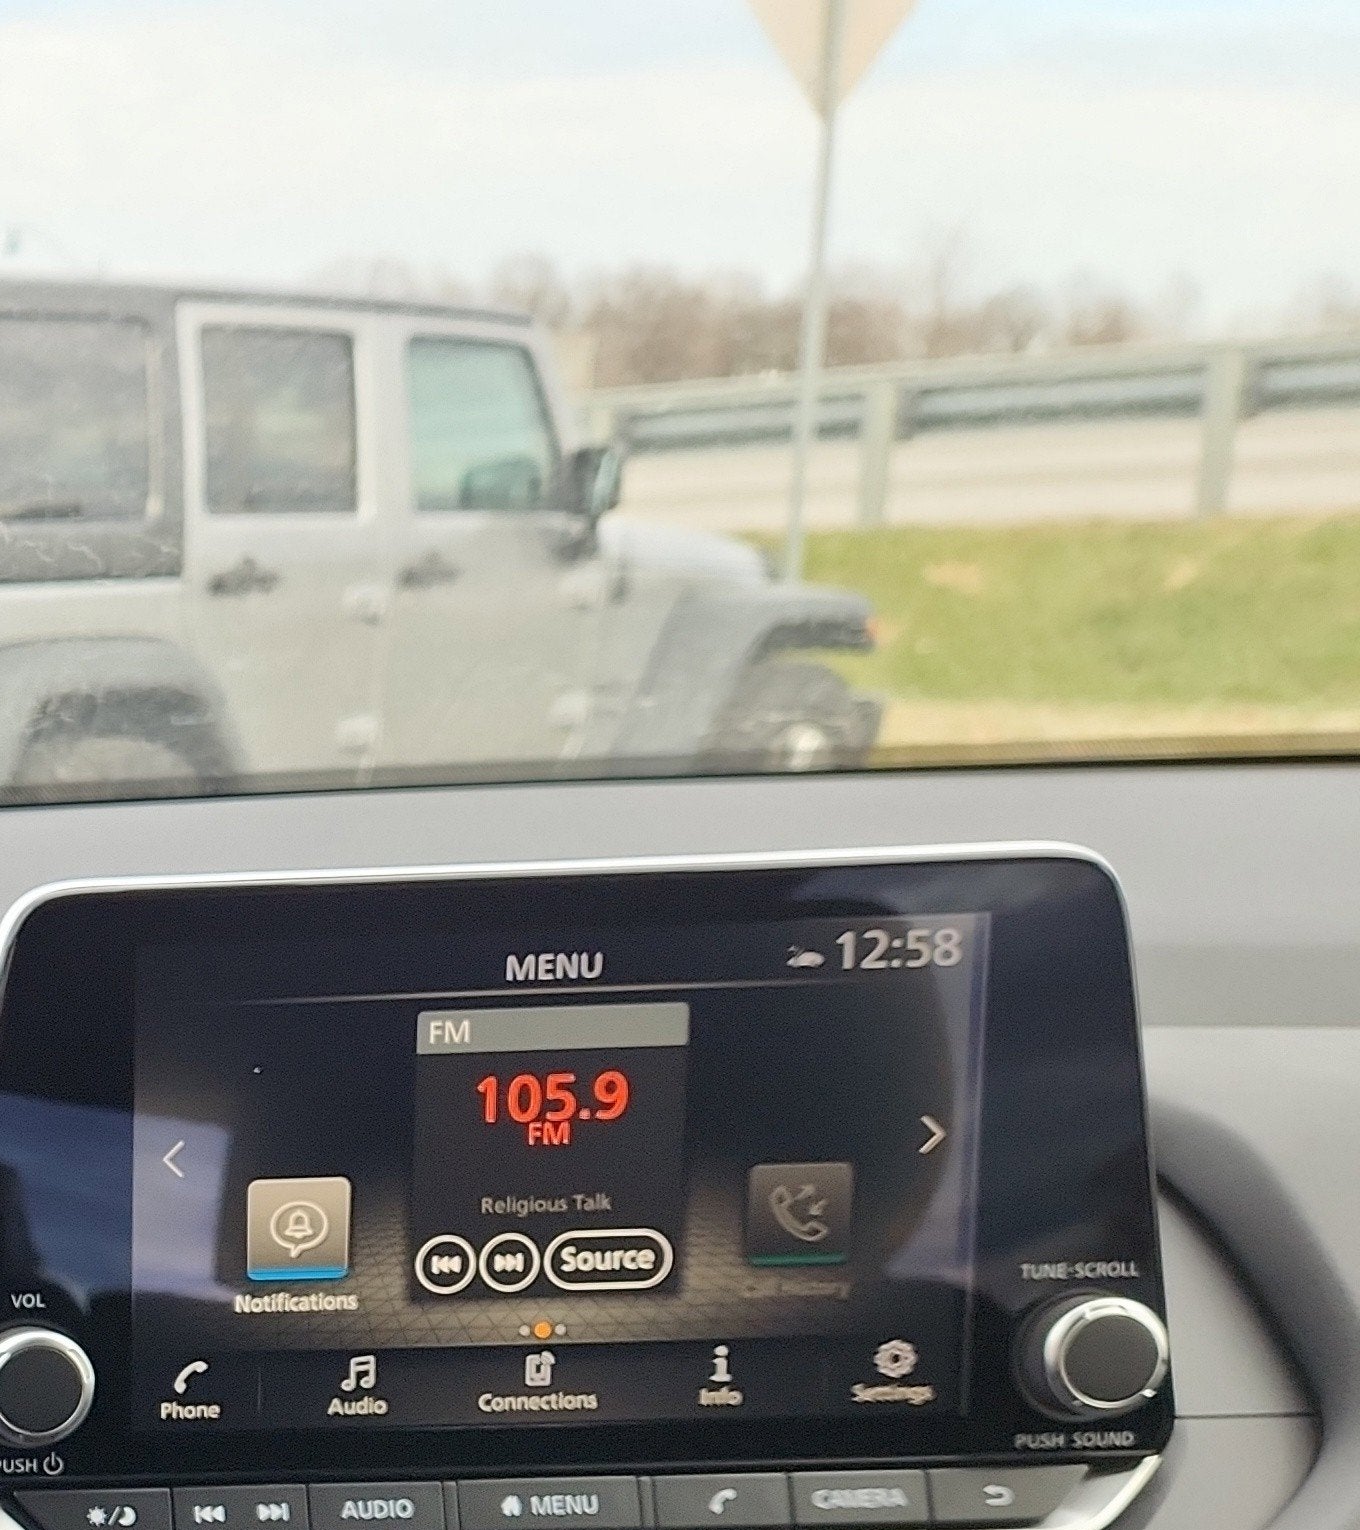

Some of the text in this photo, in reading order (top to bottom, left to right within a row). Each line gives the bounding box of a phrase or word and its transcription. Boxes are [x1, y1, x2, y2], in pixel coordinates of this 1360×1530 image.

[835, 929, 963, 971] 12:58
[506, 952, 604, 982] MENU
[429, 1020, 471, 1044] FM
[476, 1070, 629, 1123] 105.9
[528, 1122, 571, 1146] FM
[480, 1193, 613, 1218] Religious Talk
[560, 1245, 656, 1272] Source
[10, 1293, 46, 1309] VOL
[234, 1292, 359, 1315] Notifications
[327, 1396, 389, 1416] Audio
[478, 1389, 599, 1413] Connections
[698, 1388, 743, 1407] Info
[160, 1402, 221, 1420] Phone
[1015, 1431, 1135, 1448] PUSH SOUND
[341, 1498, 415, 1521] AUDIO
[530, 1494, 599, 1517] MENU
